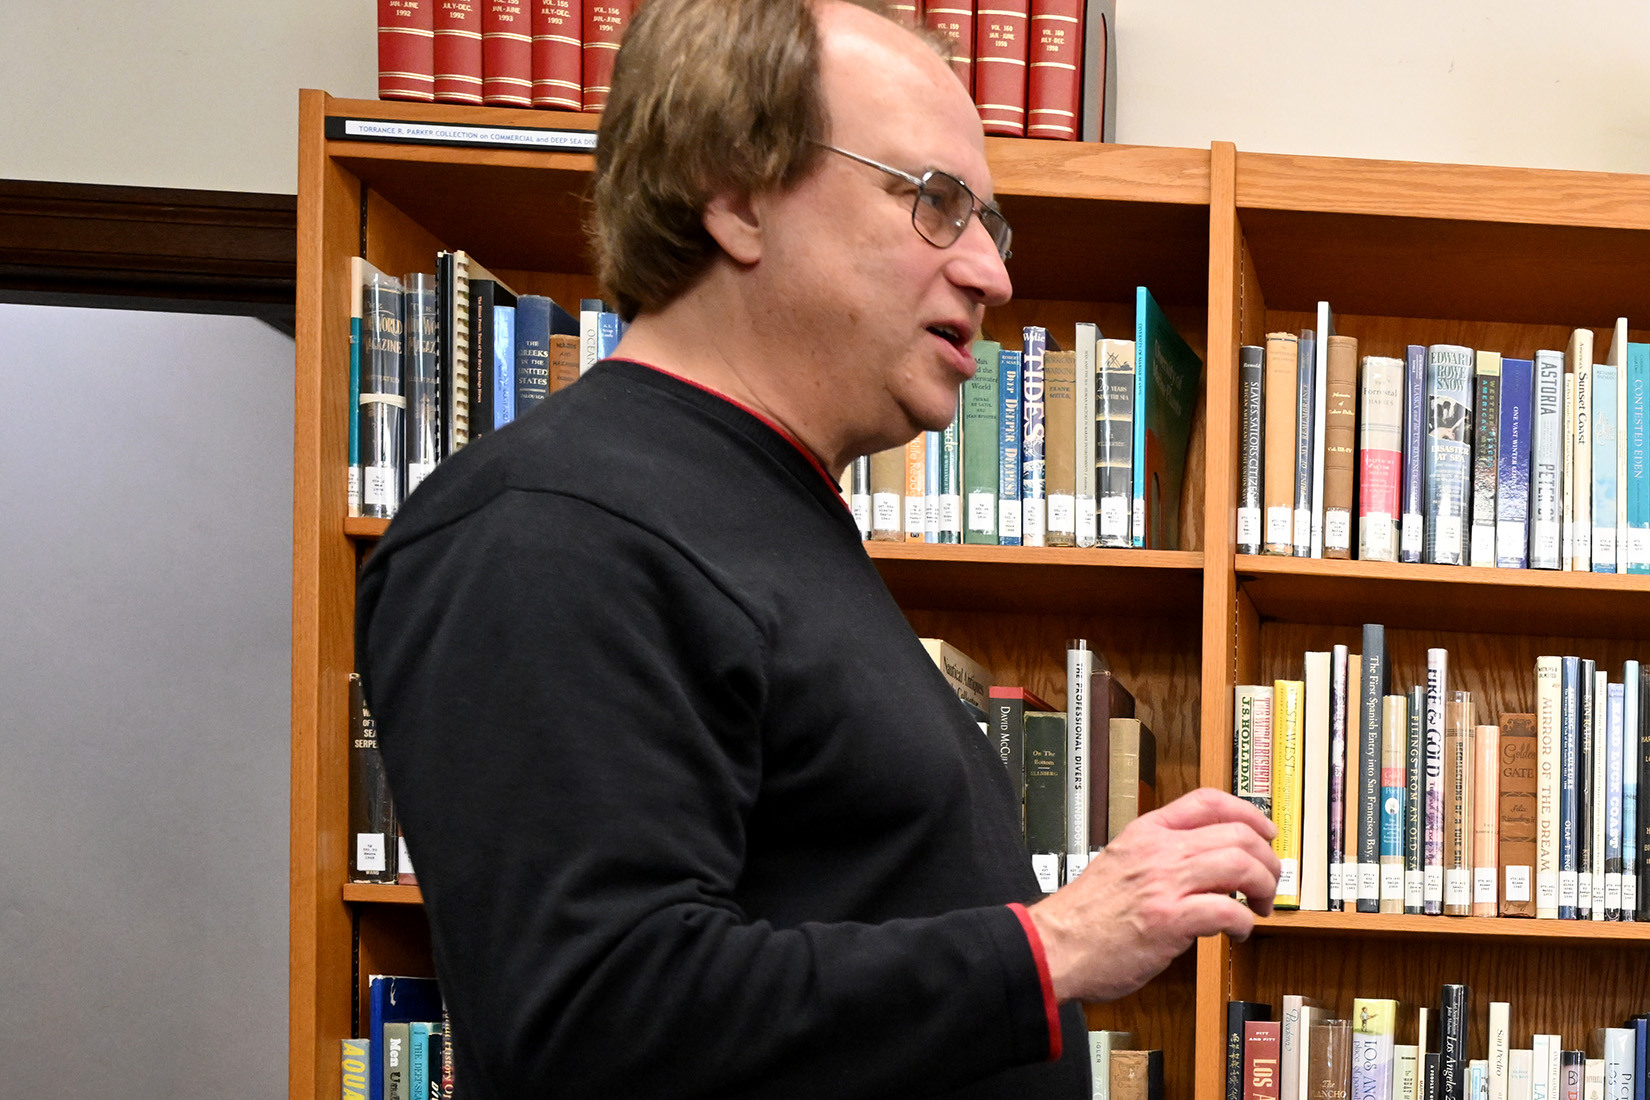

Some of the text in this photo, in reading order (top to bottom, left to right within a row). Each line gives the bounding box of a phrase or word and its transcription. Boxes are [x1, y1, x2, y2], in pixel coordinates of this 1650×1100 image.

[499, 14, 513, 22] 1993
[359, 125, 396, 134] TORRANCE
[435, 130, 478, 139] COLLECTION
[490, 133, 534, 142] COMMERCIAL
[519, 350, 548, 358] GREEKS
[1431, 352, 1472, 366] EDWARD
[518, 368, 548, 376] UNITED
[518, 376, 548, 386] STATES
[1437, 366, 1466, 379] ROWE
[1437, 378, 1465, 391] SNOW
[1024, 348, 1046, 437] TIDES
[1540, 362, 1557, 415] ASTORIA
[1578, 372, 1588, 444] Sunset Coast
[1634, 380, 1643, 479] CONTESTED EDEN
[1074, 682, 1084, 751] PROFESSIONAL
[1241, 697, 1250, 793] J.S. HOLLIDAY
[1503, 744, 1536, 764] Golden
[1074, 756, 1082, 790] DIVER'S
[1503, 768, 1534, 779] GATE
[1540, 697, 1552, 872] MIRROR OF THE DREAM
[1072, 792, 1081, 848] HANDBOOK
[390, 1039, 402, 1067] Men
[1363, 1041, 1378, 1072] LOS
[1252, 1058, 1277, 1088] Los
